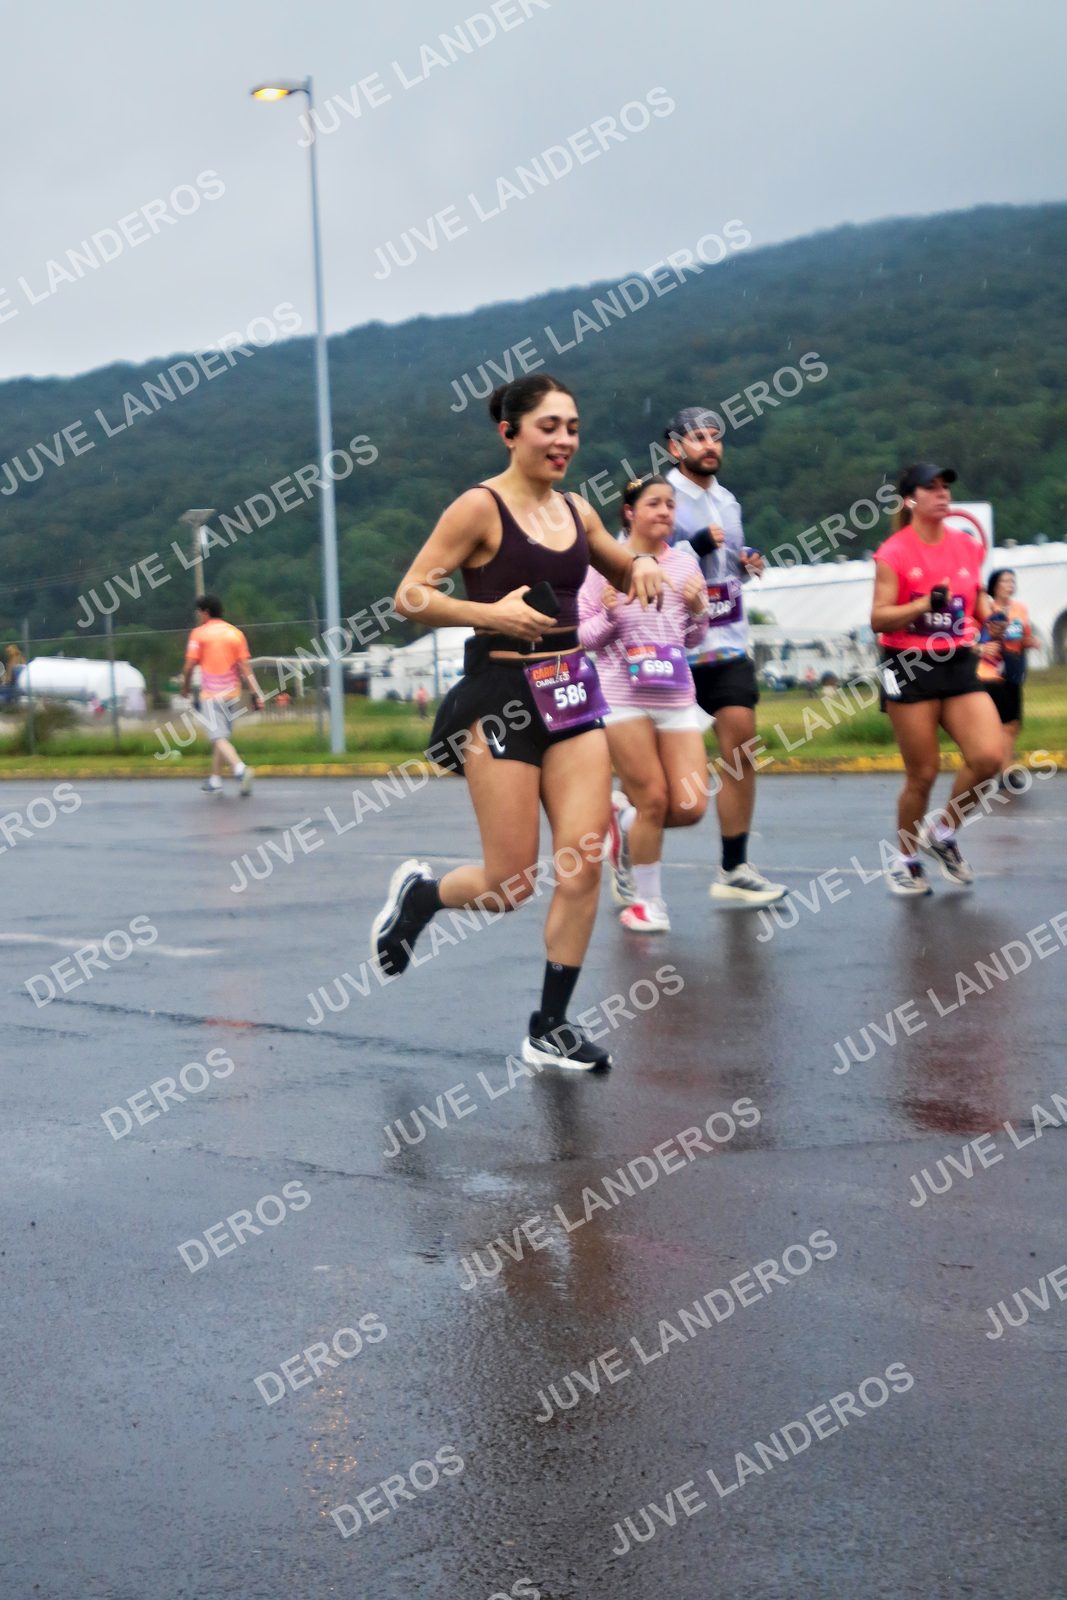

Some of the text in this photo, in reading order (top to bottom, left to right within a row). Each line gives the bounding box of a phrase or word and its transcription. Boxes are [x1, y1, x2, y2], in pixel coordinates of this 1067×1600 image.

[924, 612, 952, 627] 195
[643, 660, 674, 676] 699
[554, 681, 587, 709] 586
